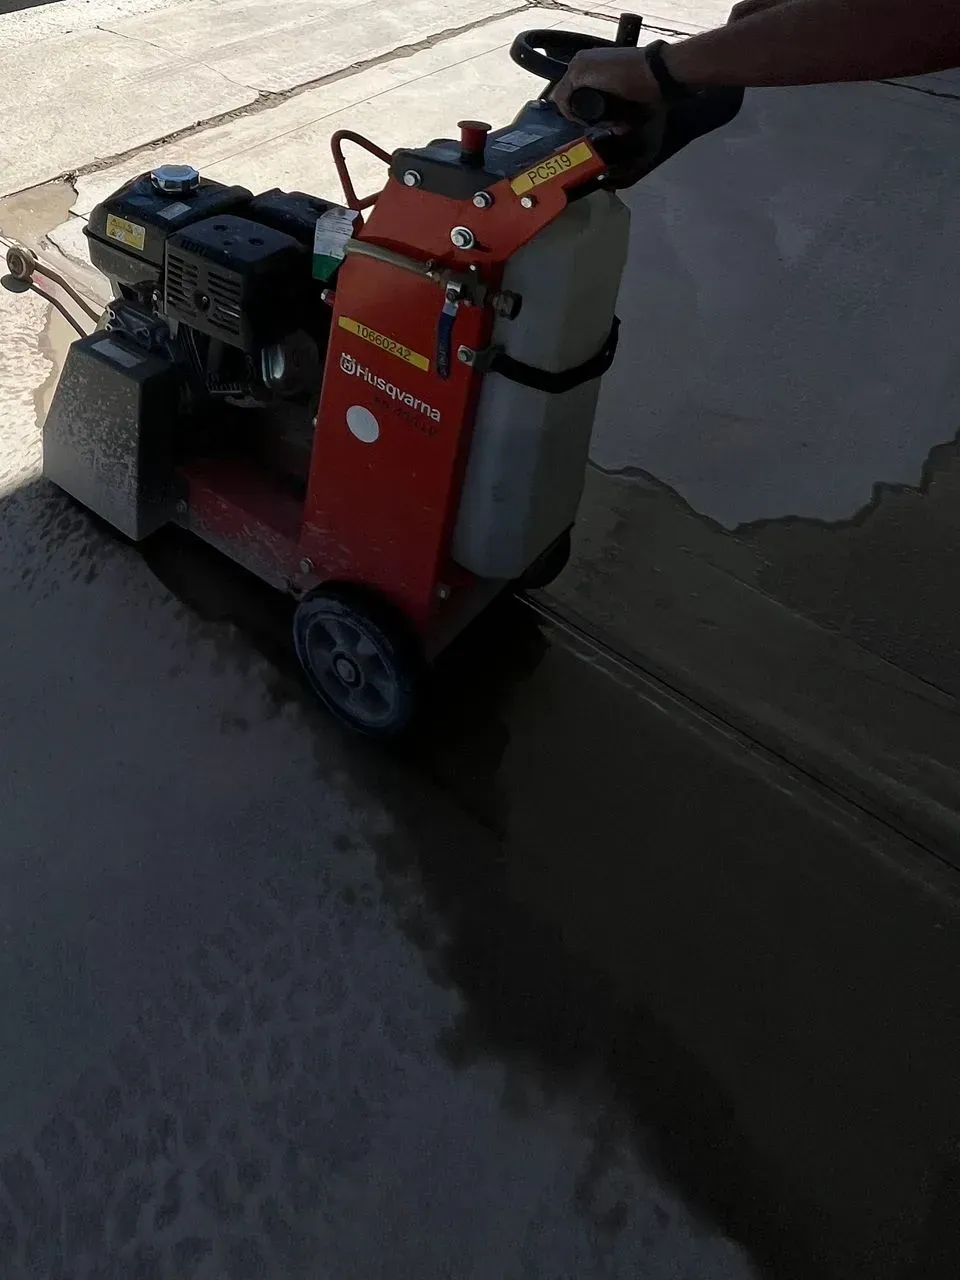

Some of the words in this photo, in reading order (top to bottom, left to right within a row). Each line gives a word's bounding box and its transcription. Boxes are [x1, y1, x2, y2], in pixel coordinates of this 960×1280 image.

[527, 154, 572, 184] PC519
[356, 325, 411, 361] 10660242
[356, 363, 441, 423] Husqvarna
